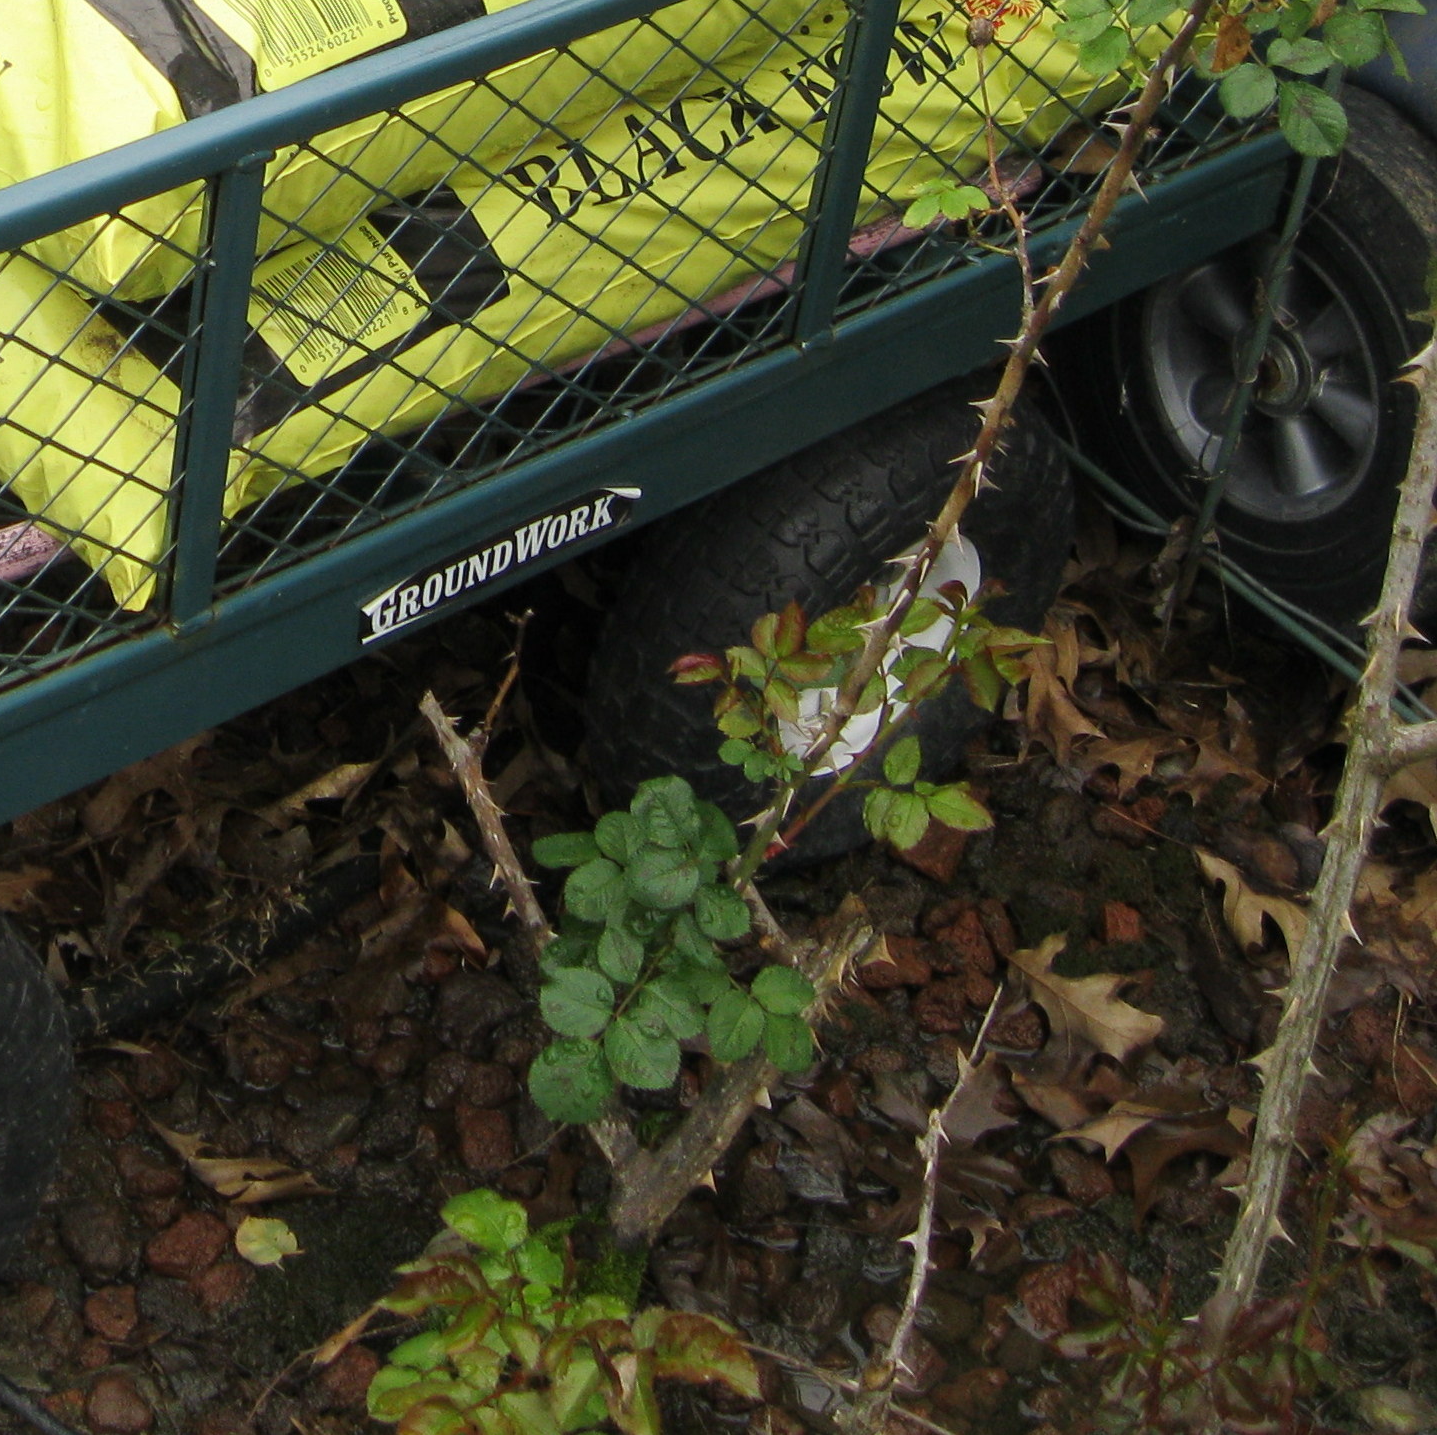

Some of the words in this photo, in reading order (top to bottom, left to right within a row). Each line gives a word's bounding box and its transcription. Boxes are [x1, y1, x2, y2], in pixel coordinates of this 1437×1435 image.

[263, 67, 273, 79] 0
[284, 46, 325, 69] 51524
[325, 25, 365, 51] 60221
